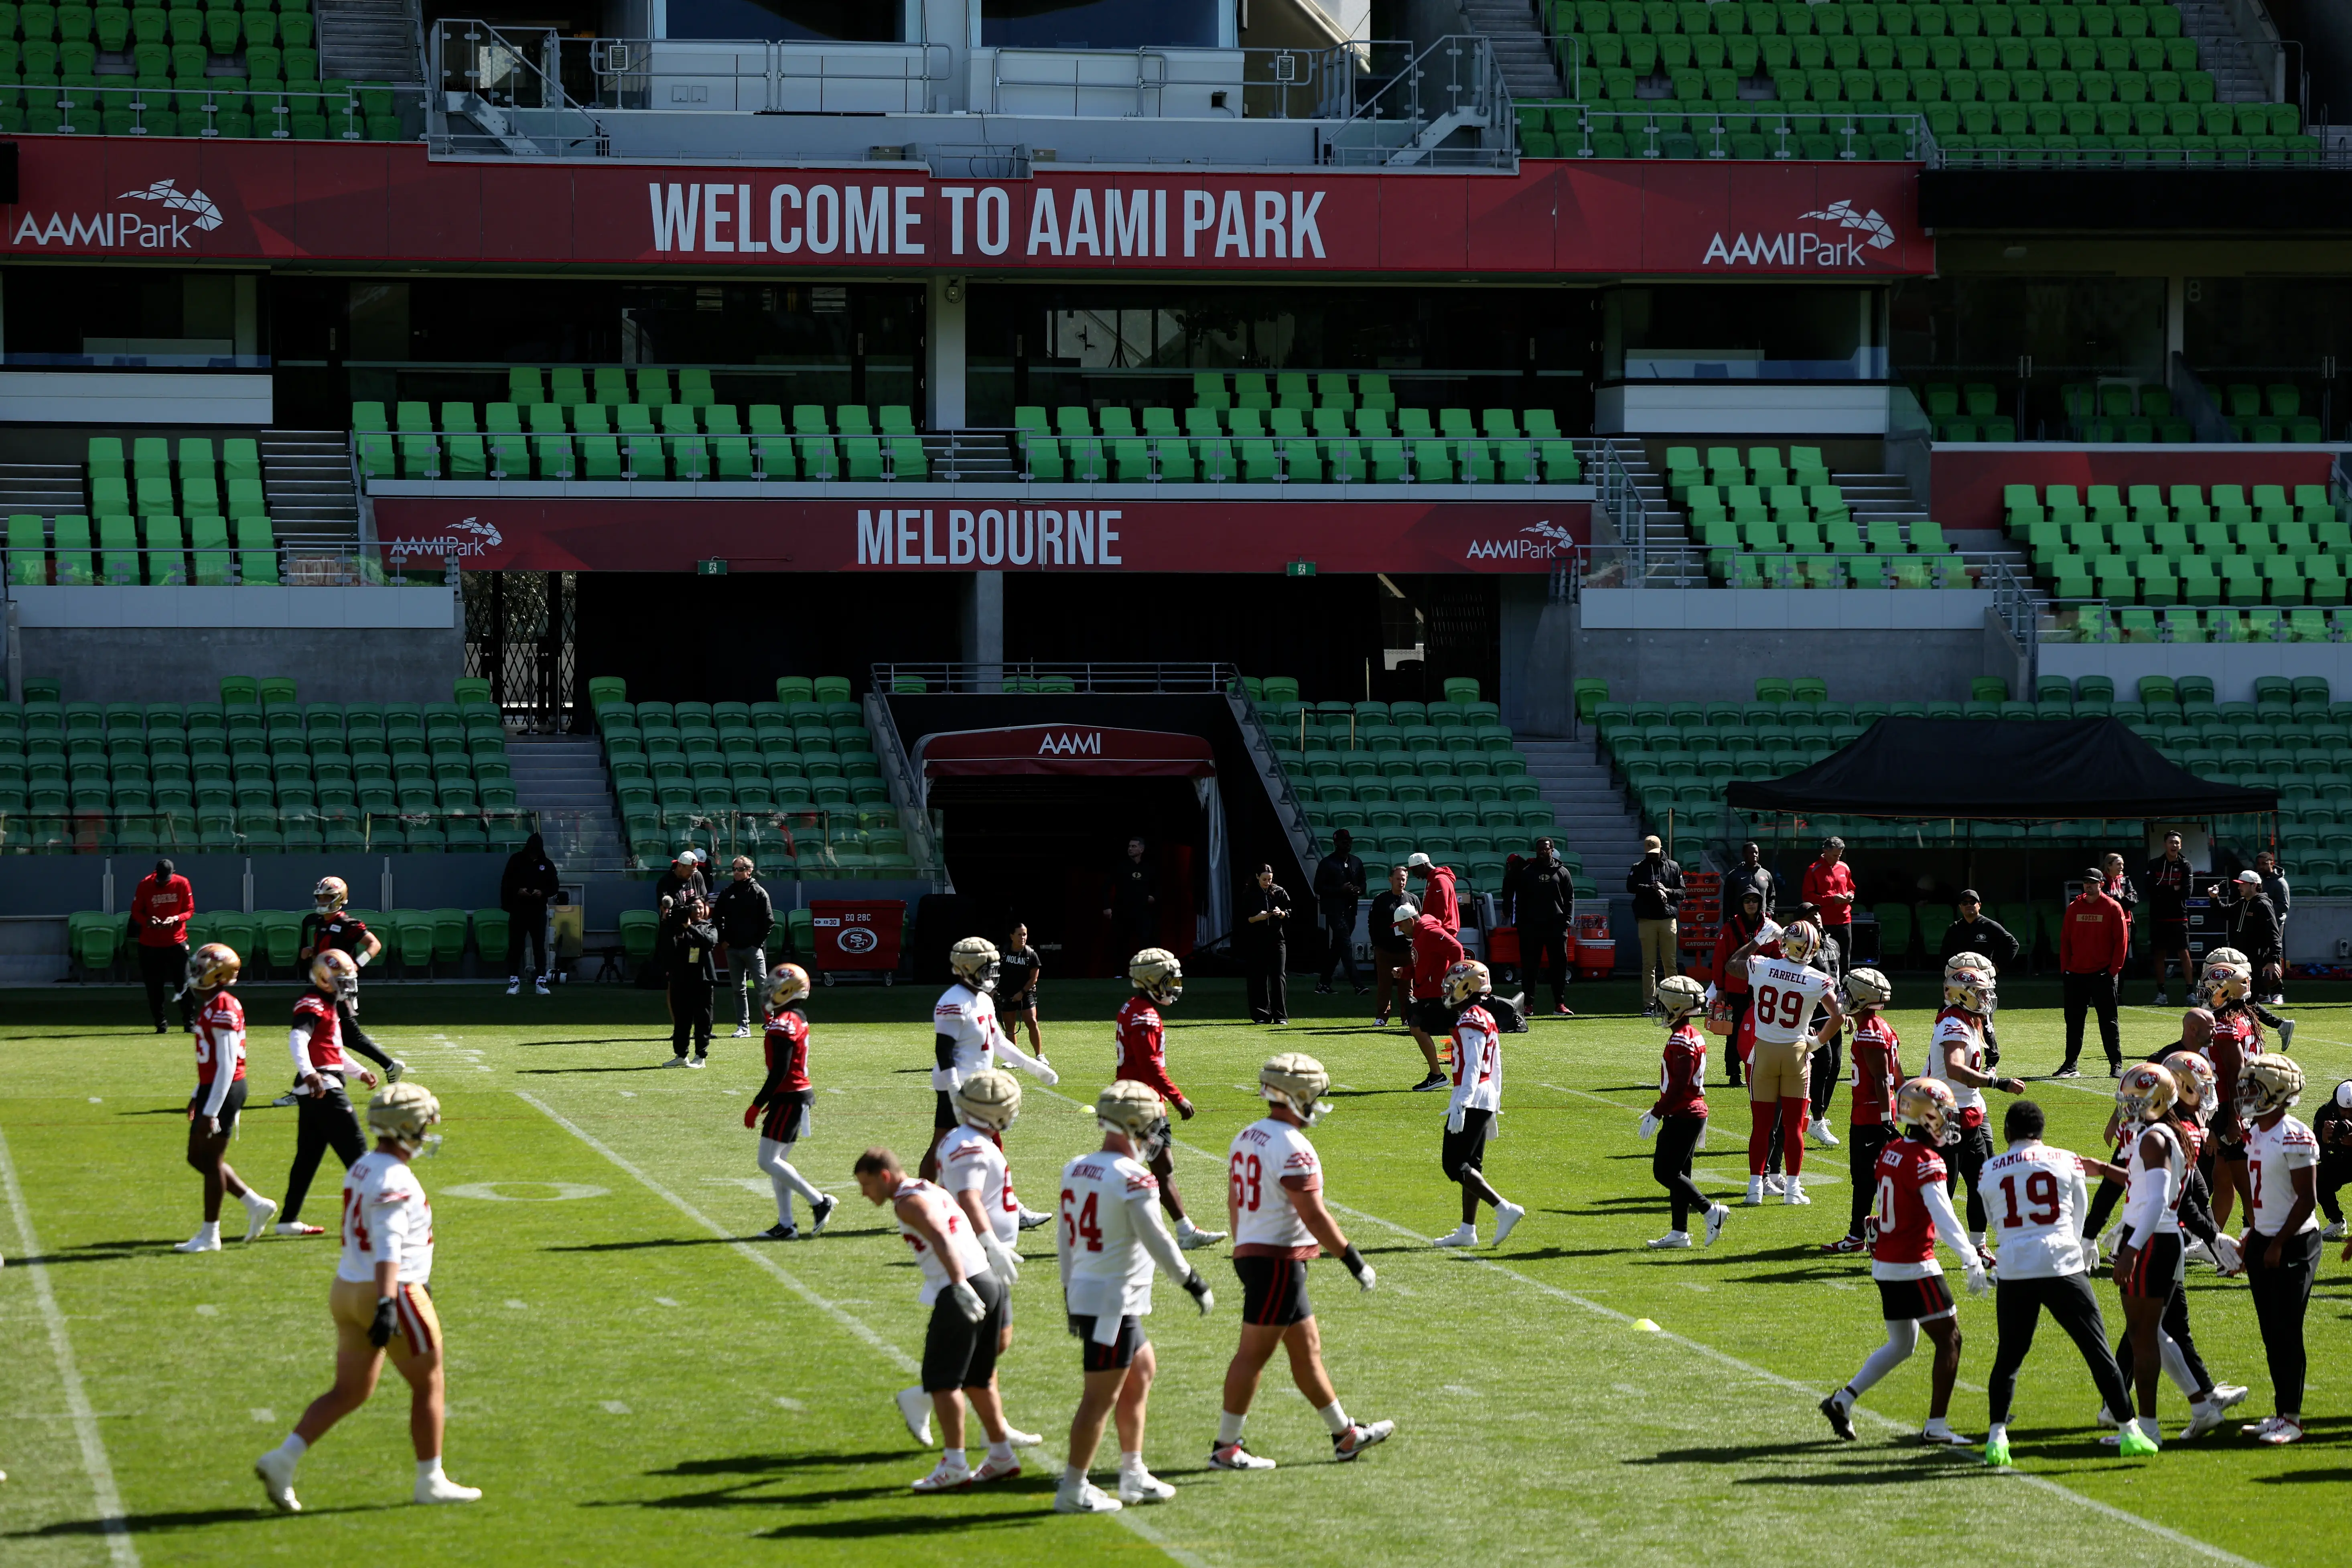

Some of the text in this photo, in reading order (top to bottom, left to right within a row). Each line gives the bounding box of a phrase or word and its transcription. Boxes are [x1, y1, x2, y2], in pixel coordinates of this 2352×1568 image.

[13, 212, 191, 248] AAMI Park
[649, 183, 1326, 258] WELCOME TO AAMI PARK
[1703, 232, 1865, 266] AAMI Park
[390, 536, 485, 556] AAMI Park
[858, 509, 1121, 566] MELBOURNE
[1467, 540, 1556, 558] AAMI Park
[1038, 732, 1100, 754] AAMI
[1006, 954, 1025, 965] NOLAN
[1768, 968, 1807, 985] FARRELL
[1758, 985, 1804, 1028] 89
[1993, 1151, 2040, 1170] SAMUEL
[1232, 1152, 1262, 1213] 68
[1999, 1171, 2060, 1228] 19
[1061, 1189, 1104, 1253] 64
